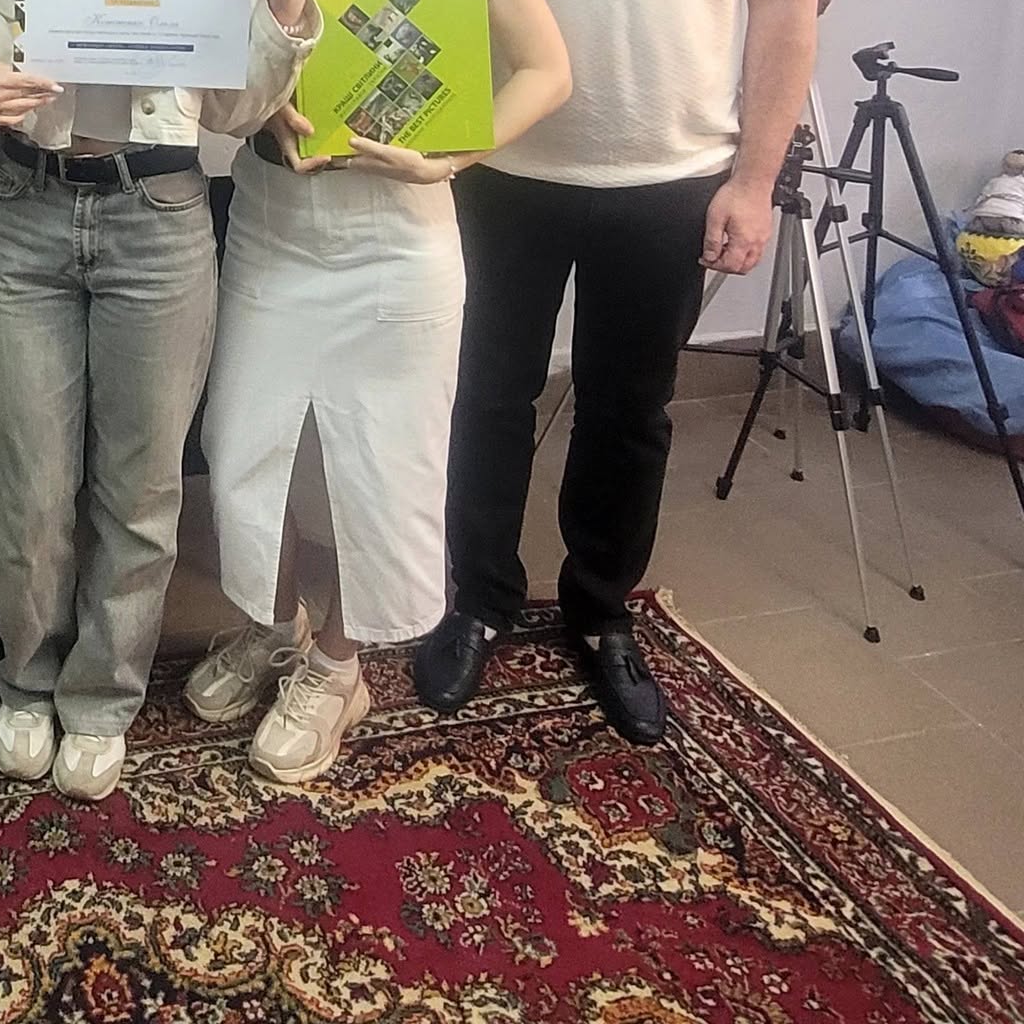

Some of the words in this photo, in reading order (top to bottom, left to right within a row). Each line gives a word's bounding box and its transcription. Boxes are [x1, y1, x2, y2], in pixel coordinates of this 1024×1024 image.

[397, 129, 413, 144] THE
[409, 116, 425, 132] BEST
[422, 87, 452, 117] PICTURES
